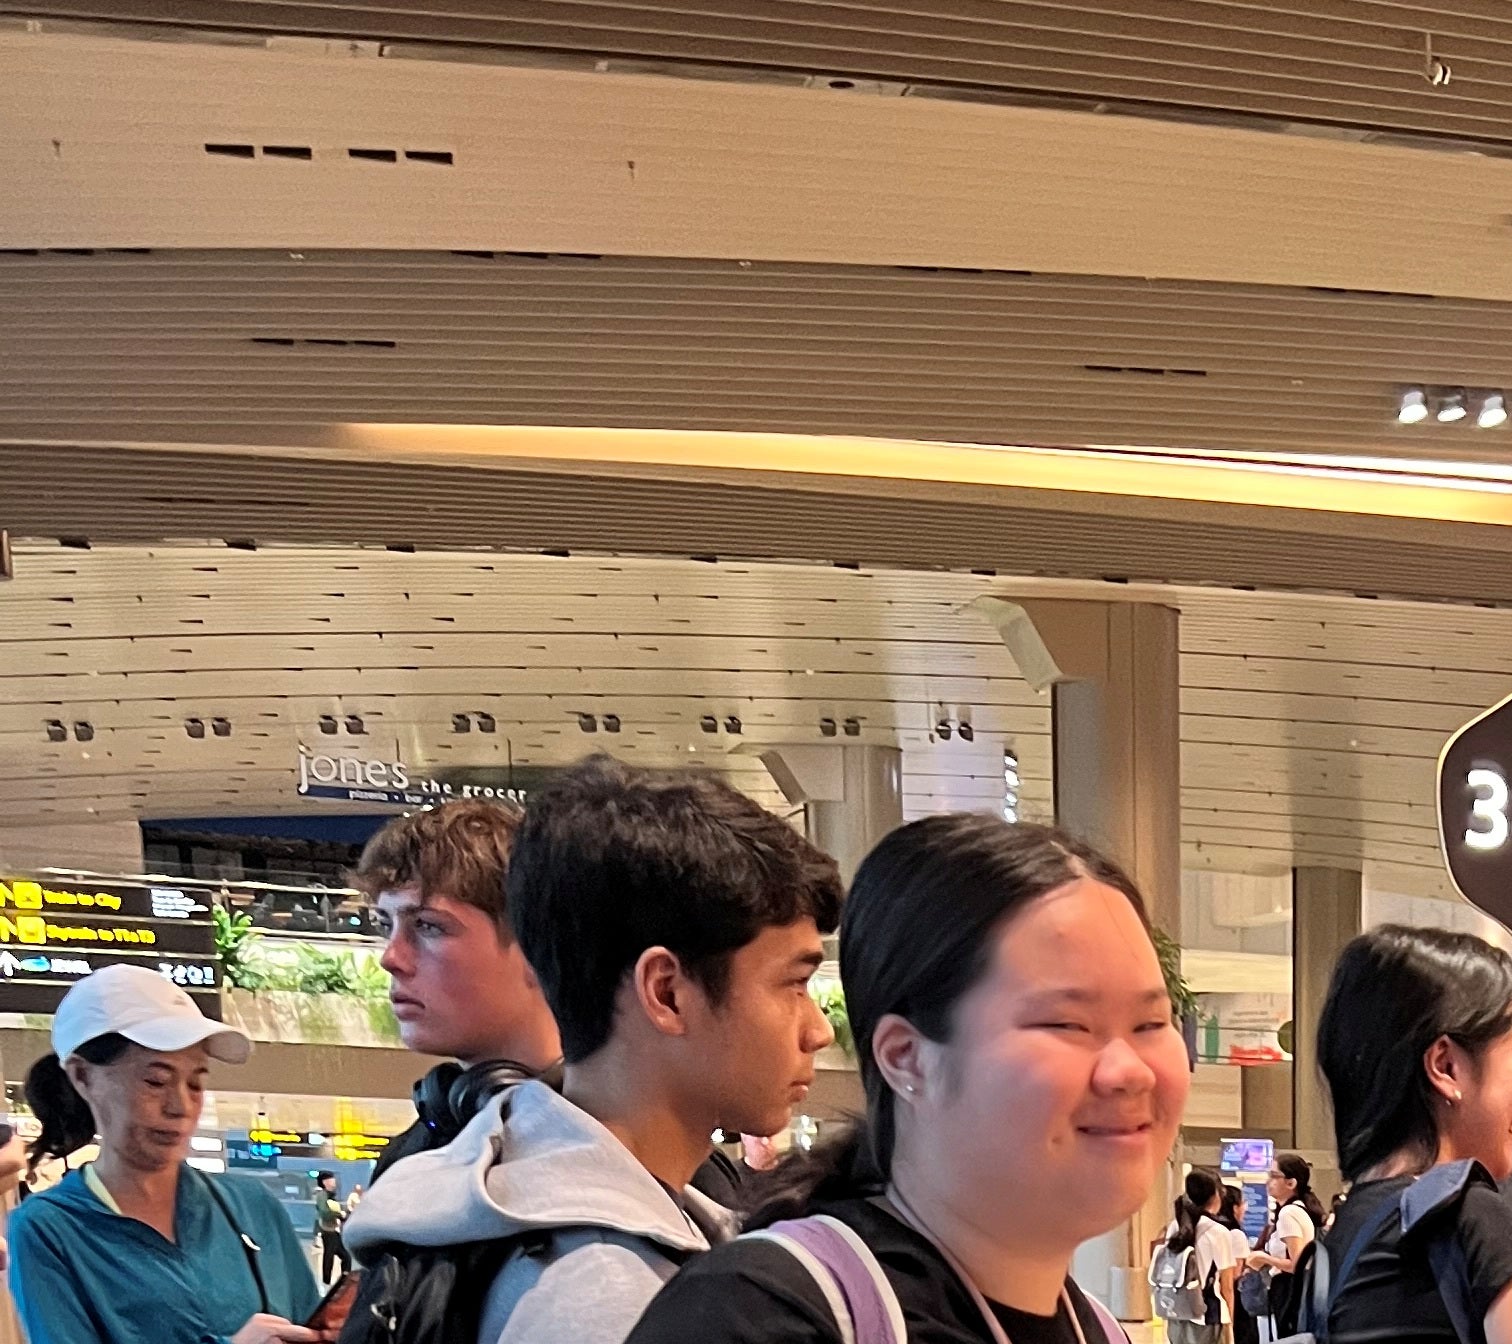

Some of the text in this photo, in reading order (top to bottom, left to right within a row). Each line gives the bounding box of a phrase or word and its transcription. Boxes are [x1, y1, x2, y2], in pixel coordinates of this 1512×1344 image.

[298, 744, 409, 793] jones
[421, 779, 452, 795] the
[462, 784, 527, 800] grocer
[1464, 768, 1510, 848] 3
